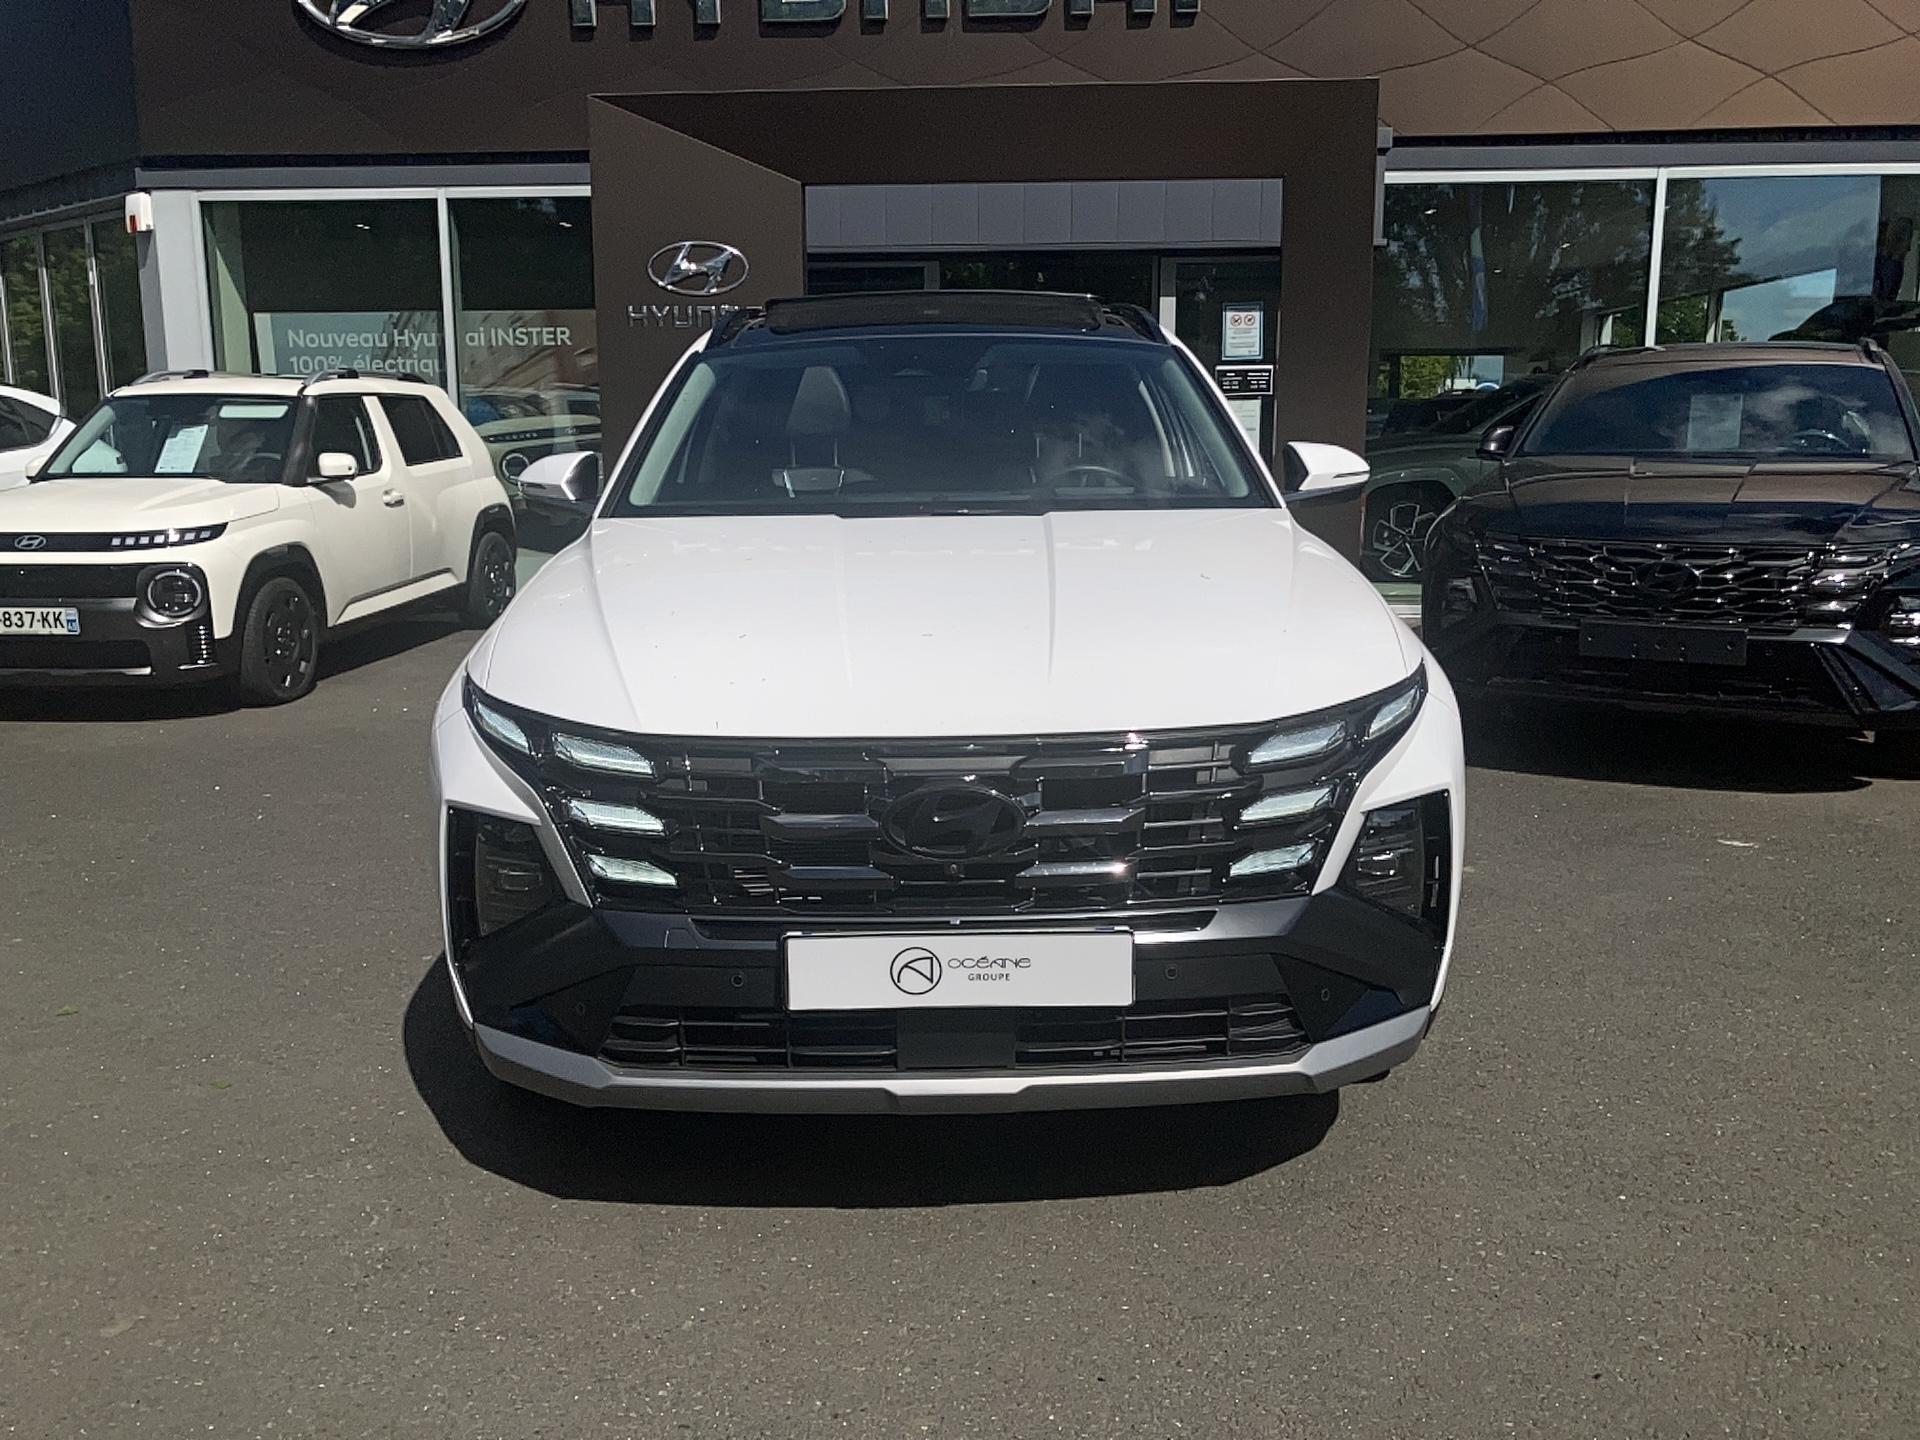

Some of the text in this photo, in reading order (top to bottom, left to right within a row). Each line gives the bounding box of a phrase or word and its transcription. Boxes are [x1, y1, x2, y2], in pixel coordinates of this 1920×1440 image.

[627, 305, 764, 328] HYUN
[287, 327, 573, 351] Nouveau Hyuai INSTER
[290, 353, 442, 377] 100% électriqu
[968, 973, 1011, 981] GROUPE
